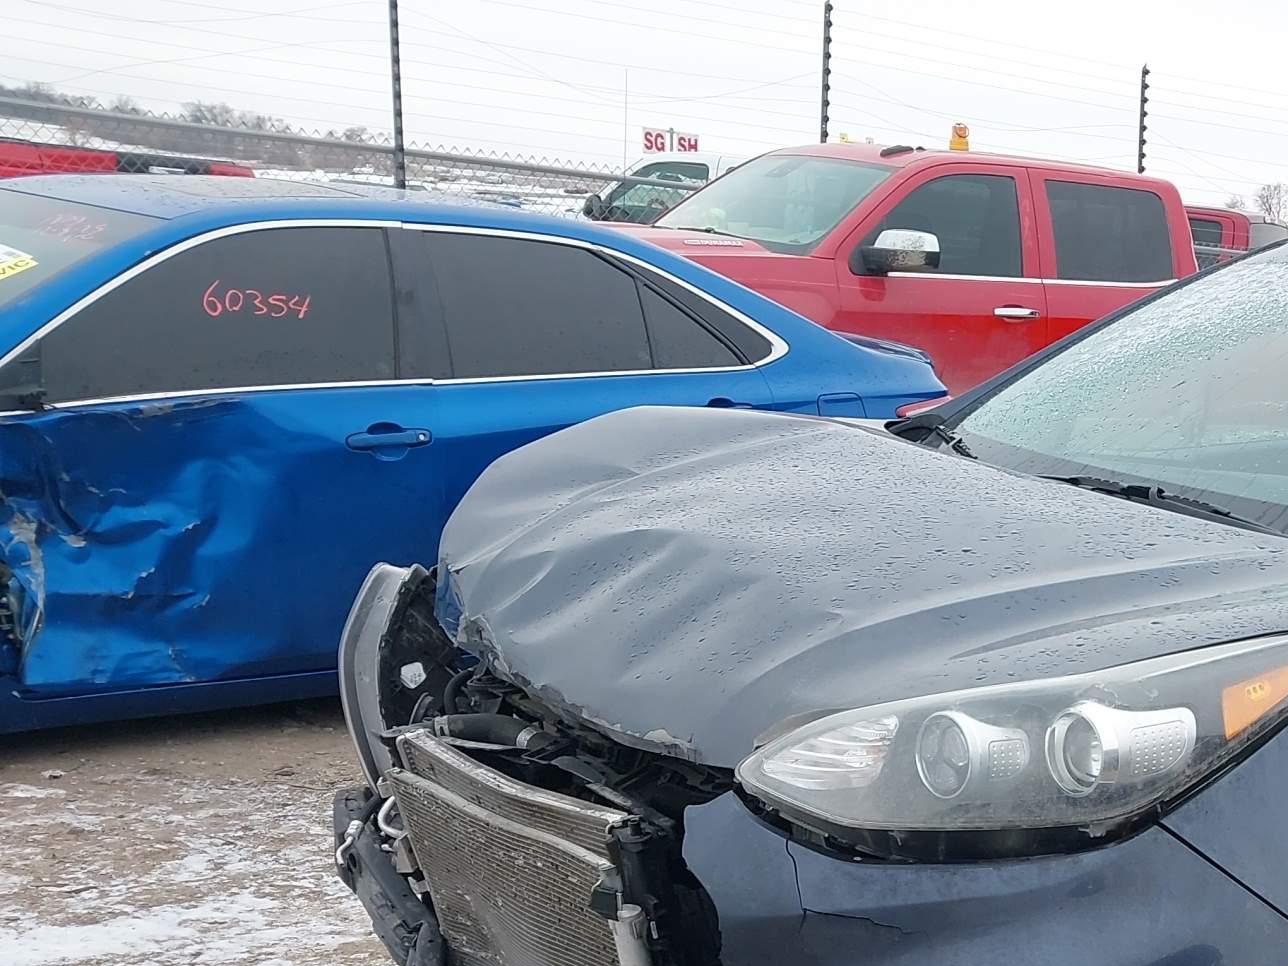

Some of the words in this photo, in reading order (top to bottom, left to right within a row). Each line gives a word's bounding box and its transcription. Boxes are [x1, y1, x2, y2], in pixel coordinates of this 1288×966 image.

[644, 131, 665, 152] SG
[677, 136, 698, 152] SH
[202, 279, 311, 320] 60354
